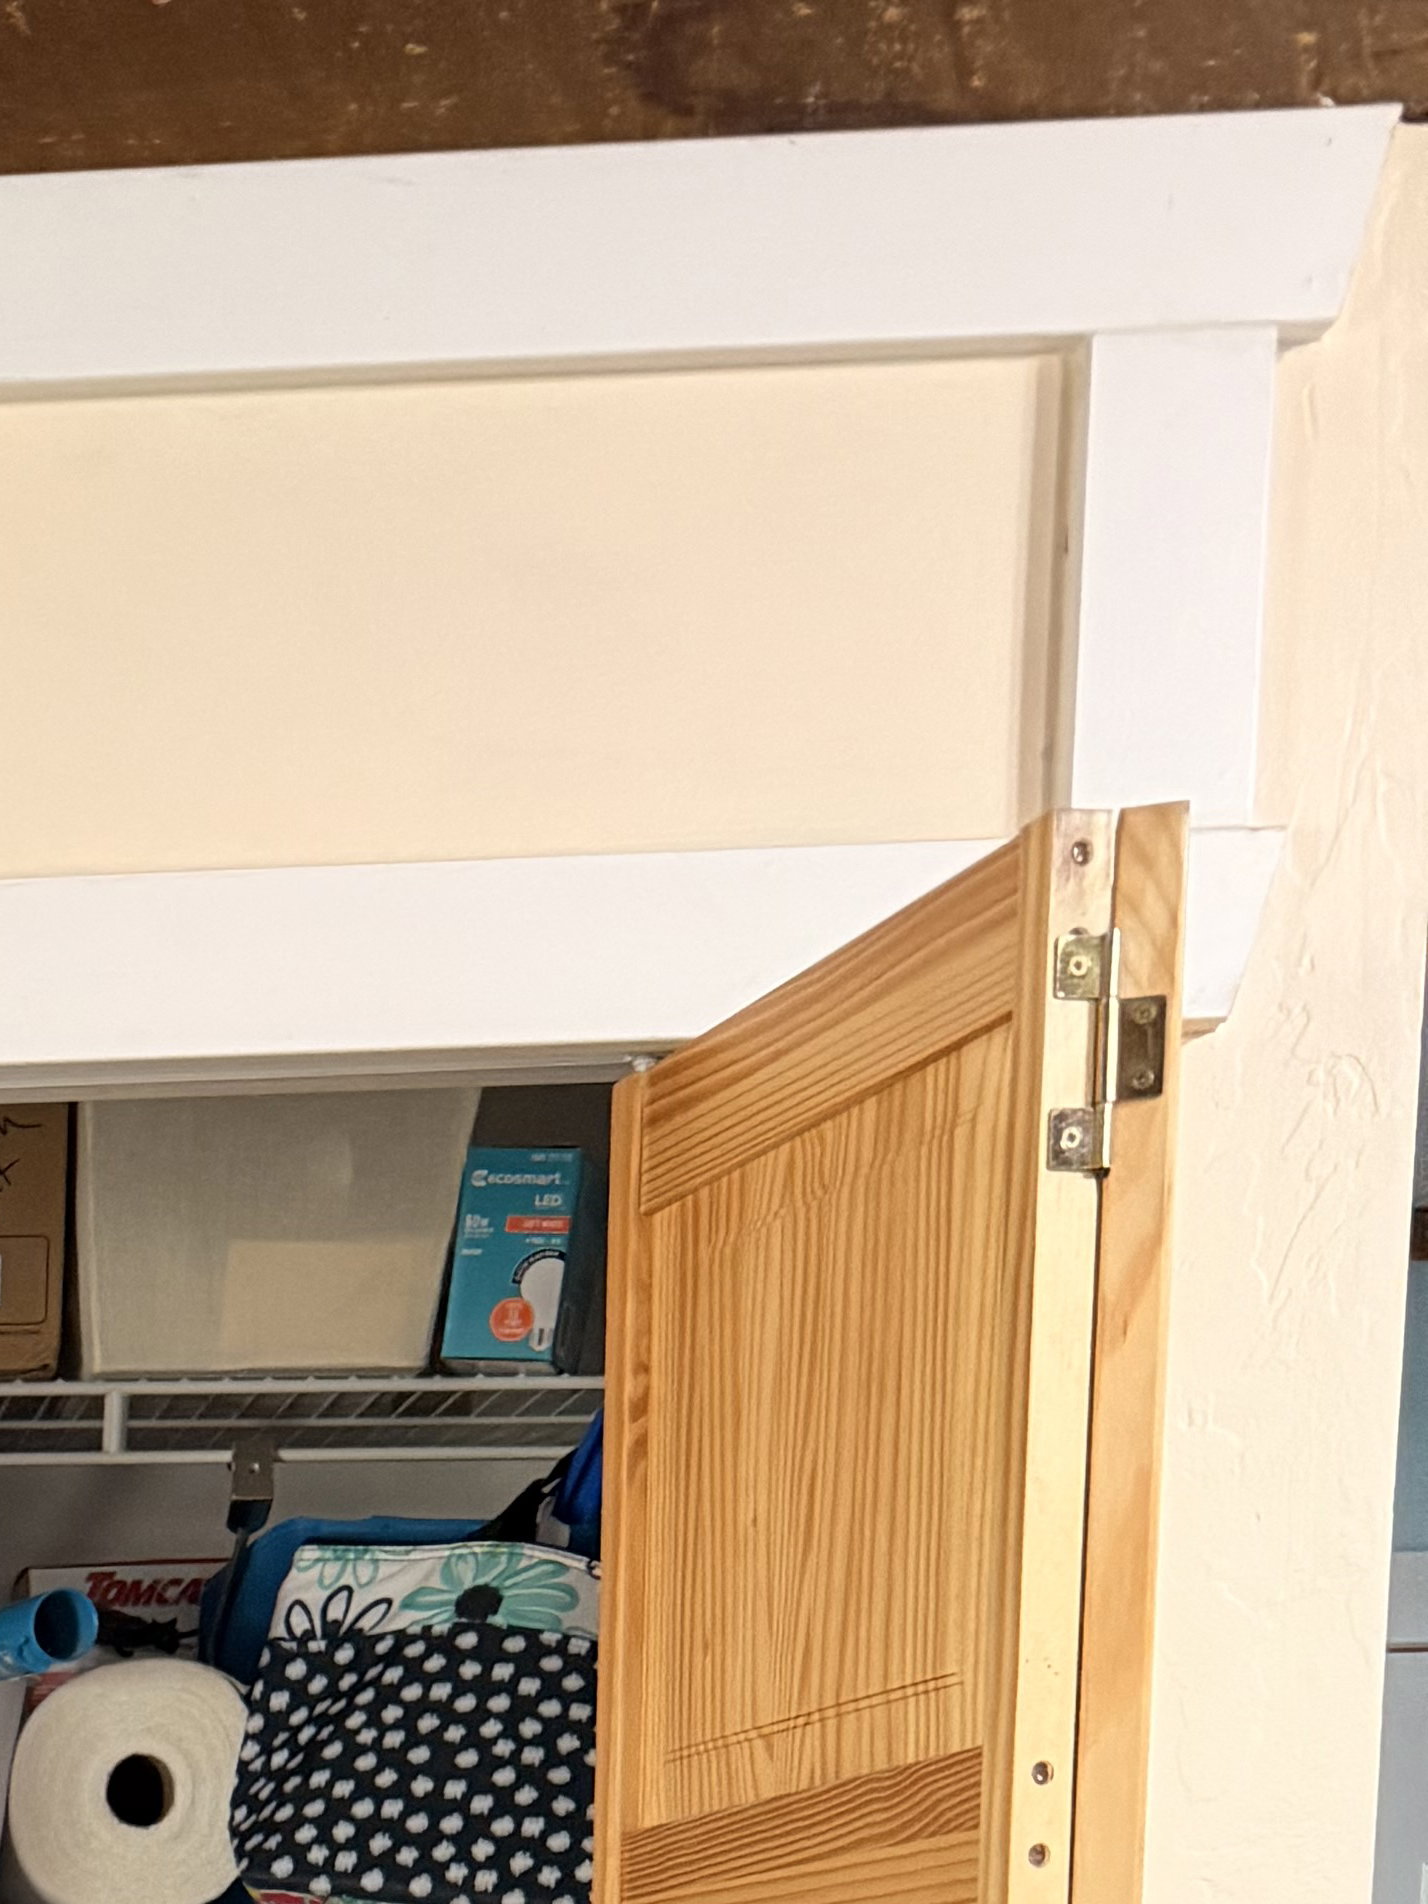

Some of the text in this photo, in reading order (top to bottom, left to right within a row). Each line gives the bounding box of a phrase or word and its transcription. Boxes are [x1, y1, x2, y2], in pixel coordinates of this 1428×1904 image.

[487, 1171, 562, 1185] ecosmart
[534, 1194, 562, 1206] LED
[87, 1571, 205, 1608] TOMCA
